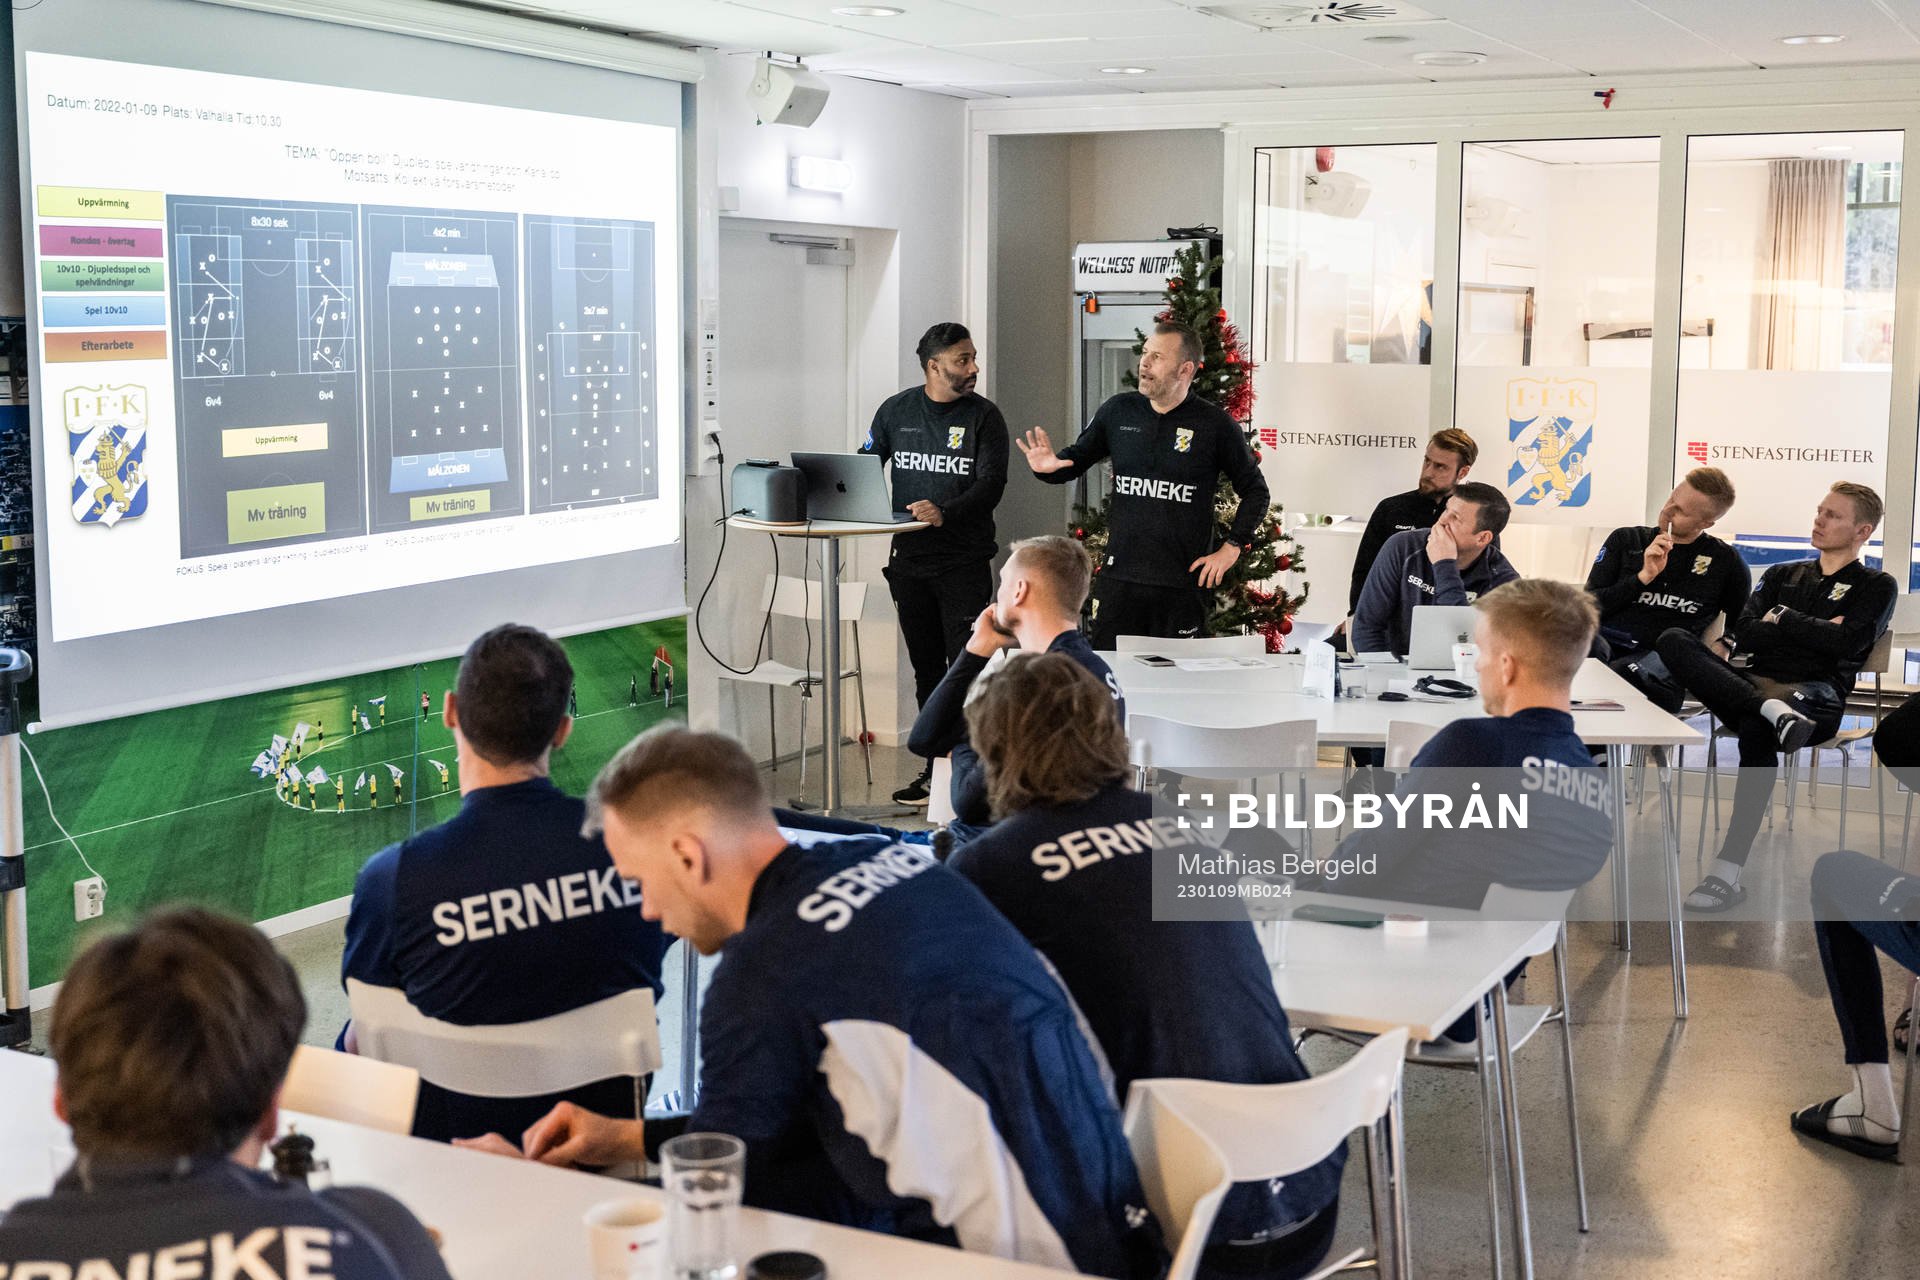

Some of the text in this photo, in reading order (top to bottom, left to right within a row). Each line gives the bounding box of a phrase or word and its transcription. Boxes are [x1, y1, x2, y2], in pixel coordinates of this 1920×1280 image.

[47, 94, 91, 111] Datum:
[94, 98, 157, 117] 2022-01-09
[250, 216, 289, 229] 8x30 sek
[57, 264, 81, 274] 10v10
[1079, 256, 1134, 274] WELLNESS
[85, 305, 128, 317] Spel 10v10
[81, 339, 134, 352] Efterarbete
[205, 396, 222, 407] 6v4
[318, 389, 334, 401] 6v4
[1280, 431, 1417, 449] STENFASTIGHETER
[1711, 445, 1874, 463] STENFASTIGHETER
[894, 451, 971, 476] SERNEKE
[1115, 474, 1195, 503] SERNEKE
[247, 504, 307, 522] Mv träning
[426, 498, 476, 513] Mv träning
